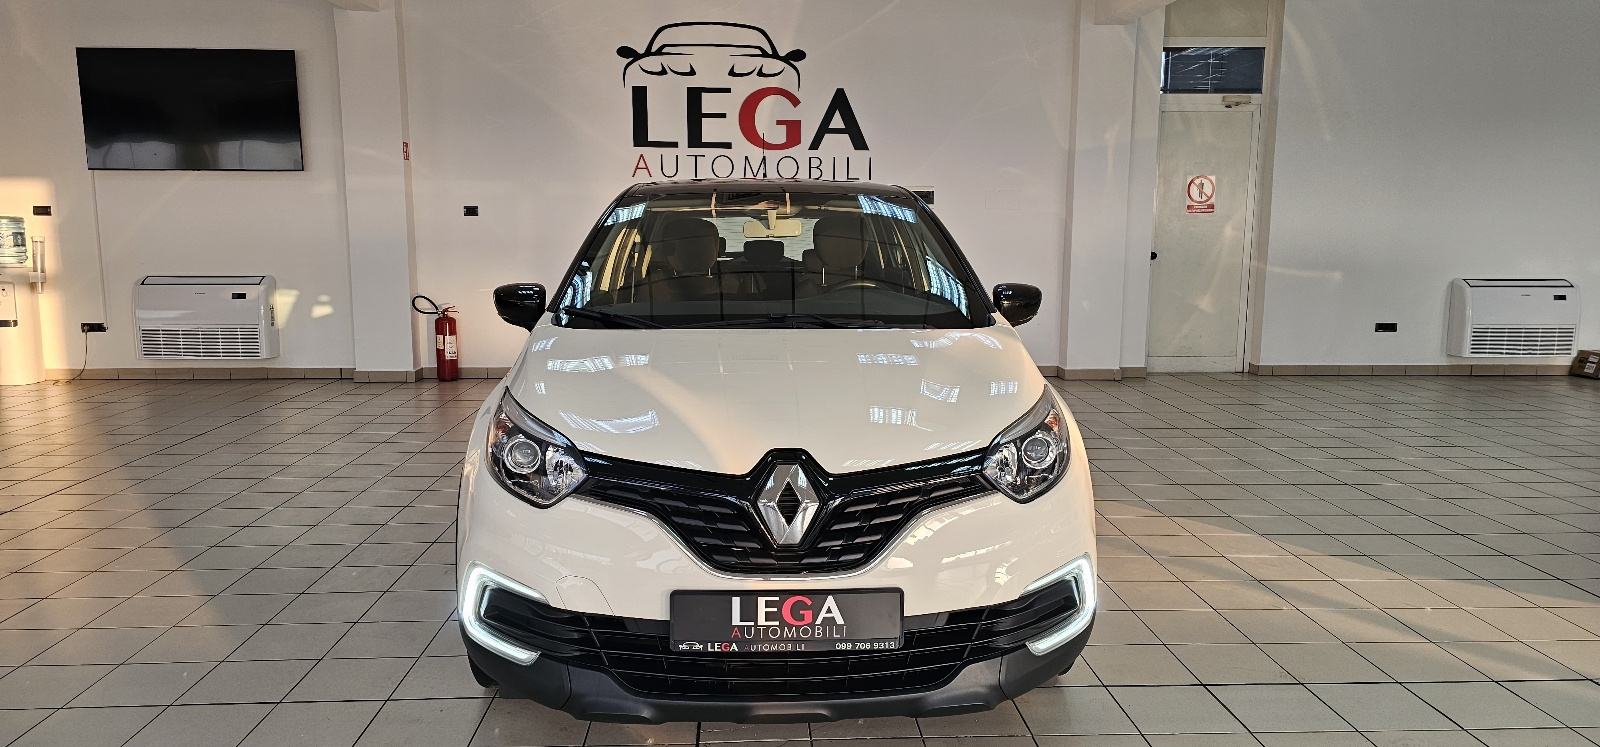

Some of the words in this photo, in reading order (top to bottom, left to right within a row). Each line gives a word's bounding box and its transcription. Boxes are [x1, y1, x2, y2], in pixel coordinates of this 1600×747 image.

[631, 86, 870, 151] LEGA
[632, 153, 872, 181] AUTOMOBILI
[731, 595, 845, 626] LEGA
[731, 625, 847, 639] AUTOMOBILI
[707, 642, 739, 652] LEGA
[744, 643, 805, 652] AUTOMOBLI
[835, 642, 852, 650] 099
[855, 642, 871, 650] 706
[873, 641, 895, 649] 9313
